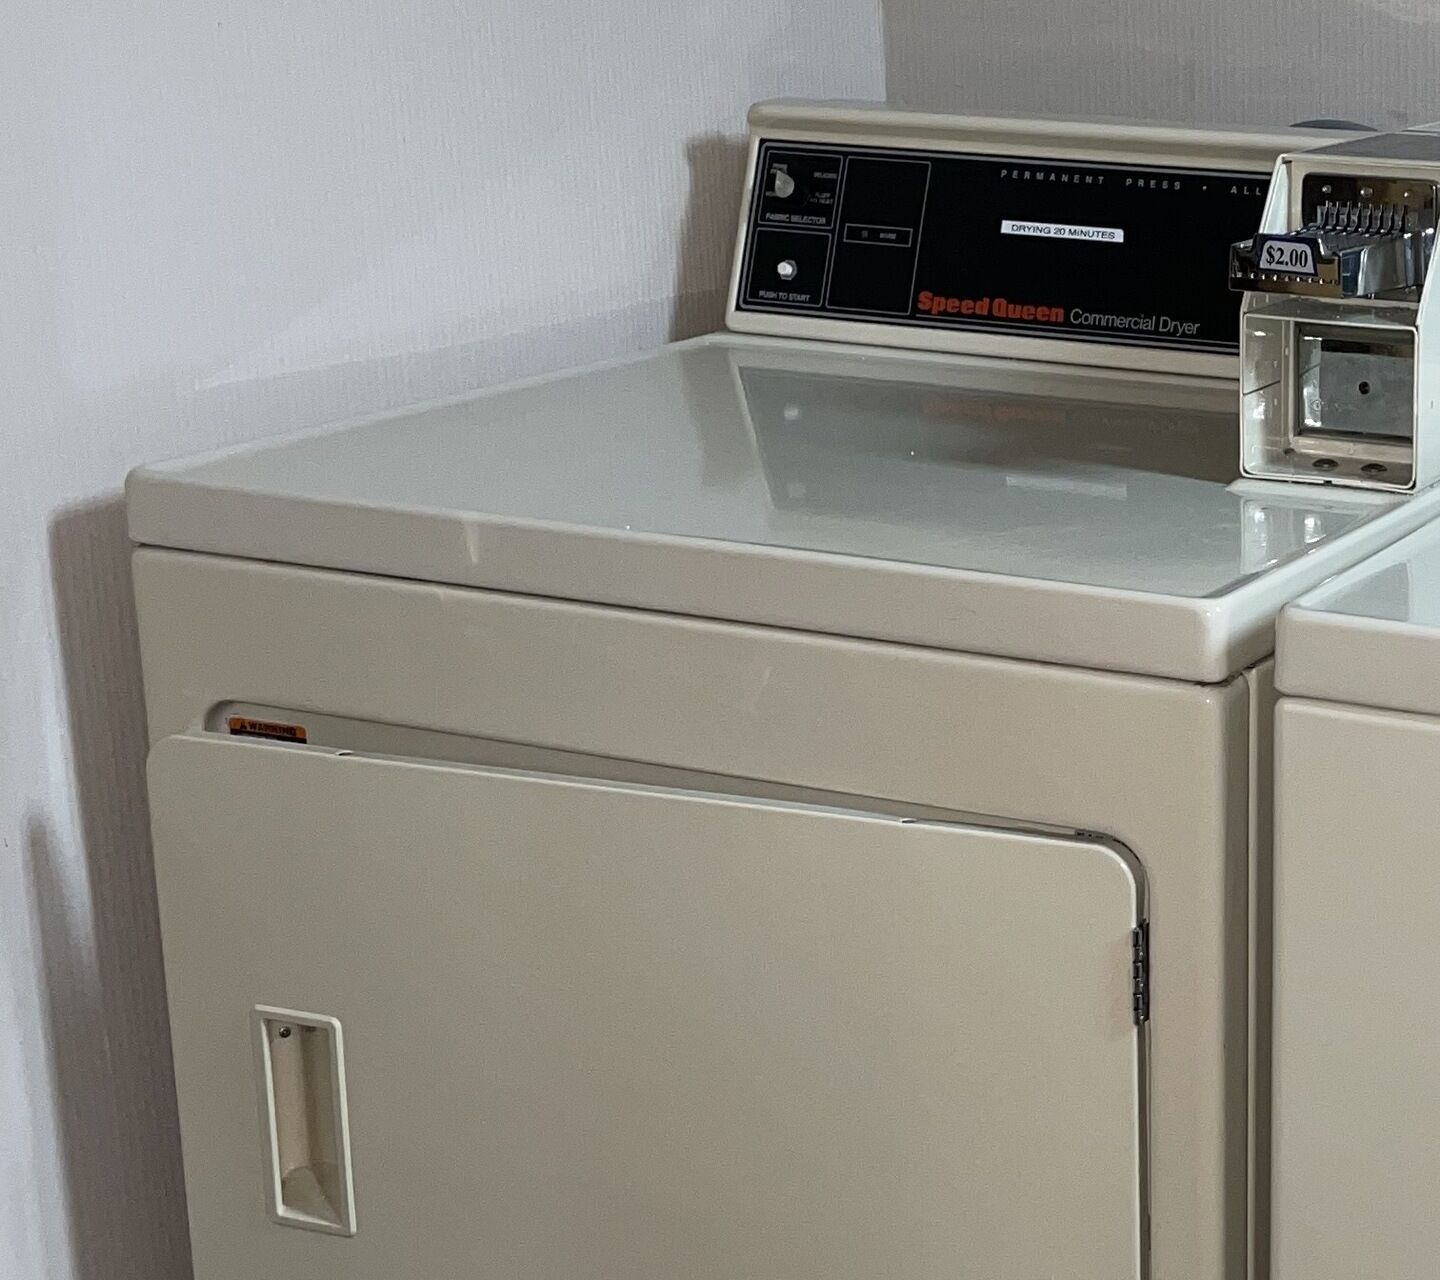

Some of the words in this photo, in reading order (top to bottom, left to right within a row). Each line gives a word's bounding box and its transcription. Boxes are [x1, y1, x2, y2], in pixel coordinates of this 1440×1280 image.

[1000, 169, 1105, 185] PERMANENT
[1125, 177, 1182, 191] PRESS
[1230, 185, 1262, 196] ALL
[1010, 223, 1051, 235] DRYING
[1053, 227, 1067, 237] 20
[1068, 228, 1116, 241] MINUTES
[1265, 244, 1309, 269] $2.00
[917, 289, 989, 316] Speed
[992, 298, 1064, 322] Queen
[1070, 308, 1155, 331] Commercial
[1158, 312, 1200, 336] Dryer
